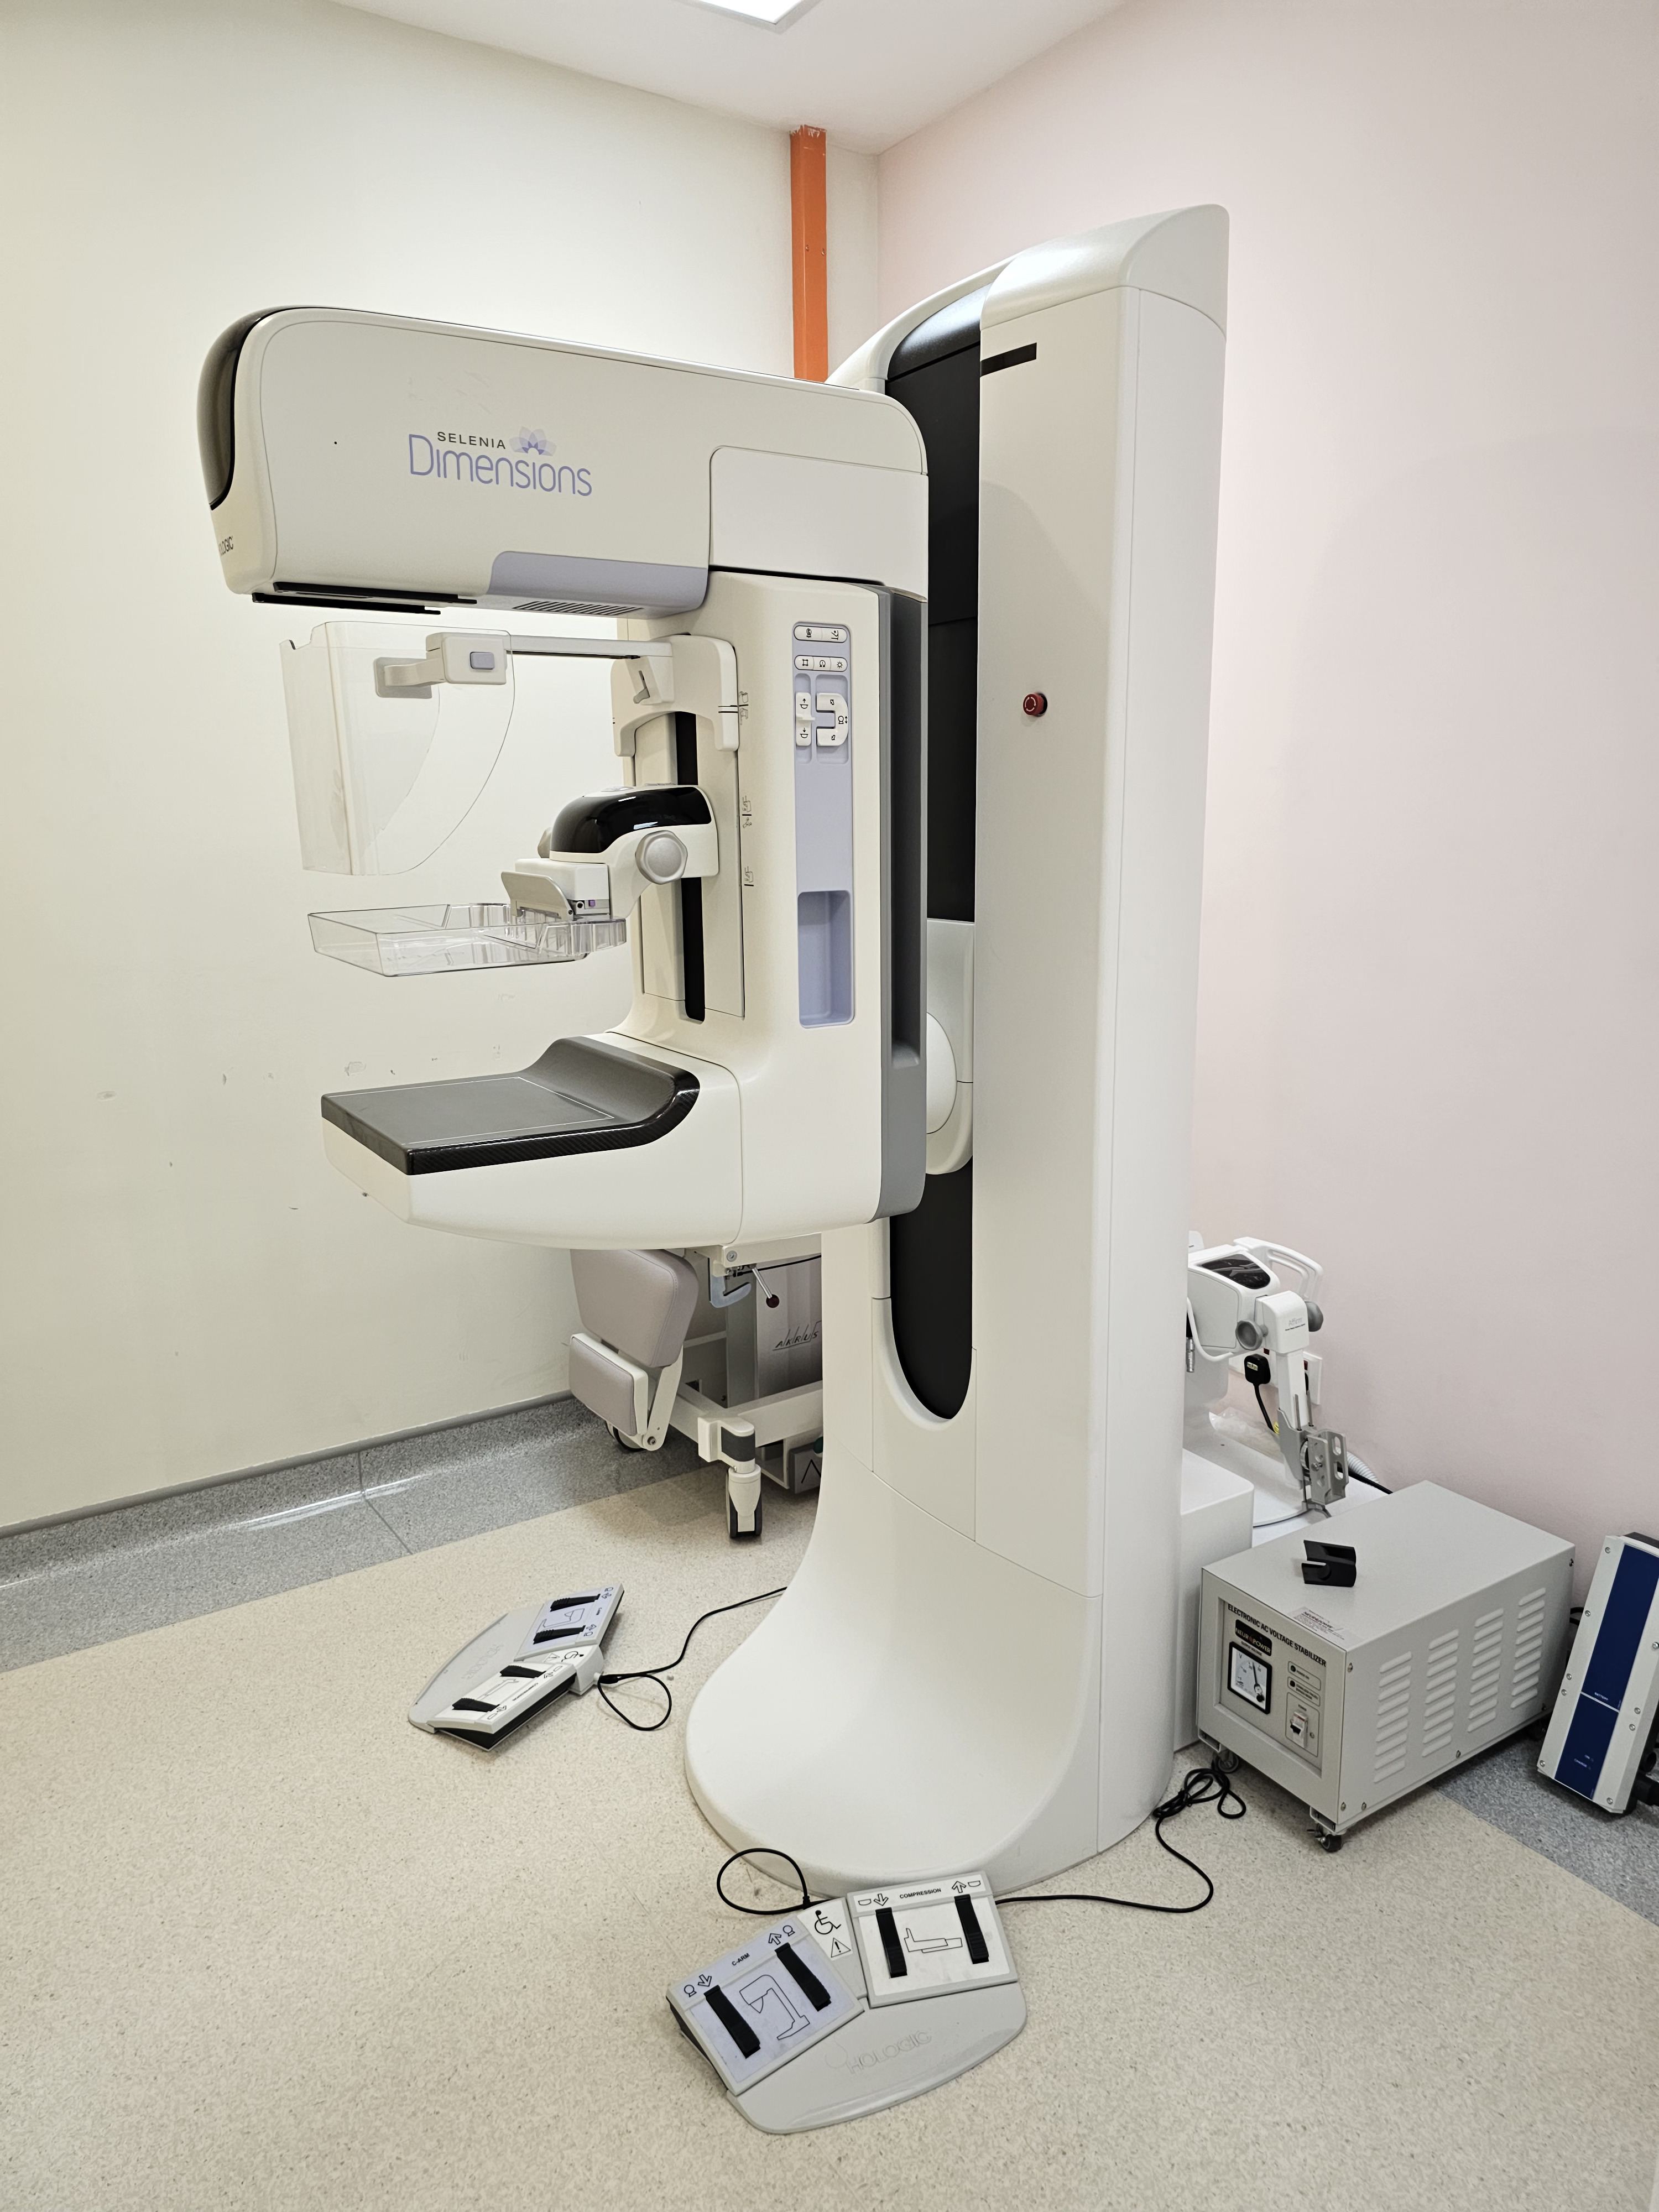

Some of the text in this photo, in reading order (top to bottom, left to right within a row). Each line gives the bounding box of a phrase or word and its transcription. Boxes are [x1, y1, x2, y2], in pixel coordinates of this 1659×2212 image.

[437, 431, 505, 449] SELENIA
[409, 434, 592, 497] Dimensions
[775, 1331, 819, 1348] AKRUS
[1228, 1604, 1260, 1627] ELECTRONIC
[1261, 1623, 1269, 1632] AC
[1269, 1627, 1293, 1648] VOLTAGE
[1294, 1642, 1327, 1667] STABILIZER
[900, 1887, 942, 1899] COMPRESSION
[732, 1953, 750, 1966] C-ARM
[846, 2031, 932, 2075] HOLOGIC
